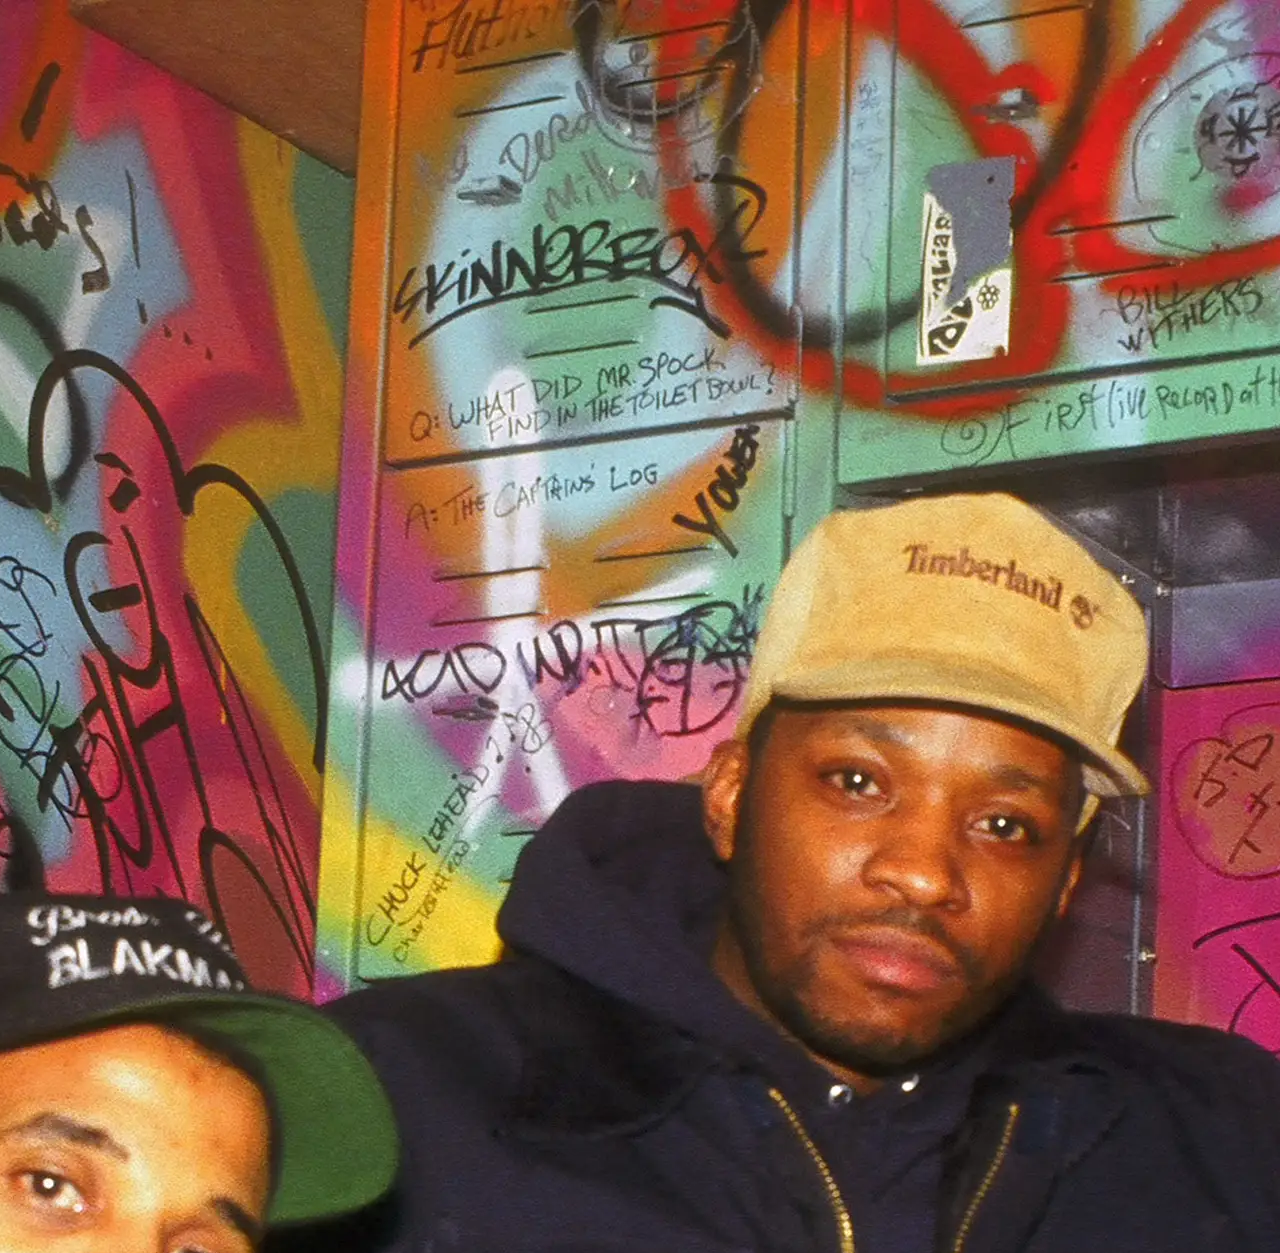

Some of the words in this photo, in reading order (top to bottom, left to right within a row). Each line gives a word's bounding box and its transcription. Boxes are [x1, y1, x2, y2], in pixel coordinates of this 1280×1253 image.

[448, 383, 525, 430] WHAT
[530, 376, 583, 403] DID
[488, 410, 554, 442] FIND
[557, 405, 579, 428] IN
[585, 396, 624, 422] THE
[624, 378, 704, 416] TOILET
[442, 485, 487, 526] THE
[609, 462, 659, 491] LOG
[904, 540, 1065, 613] Timberland
